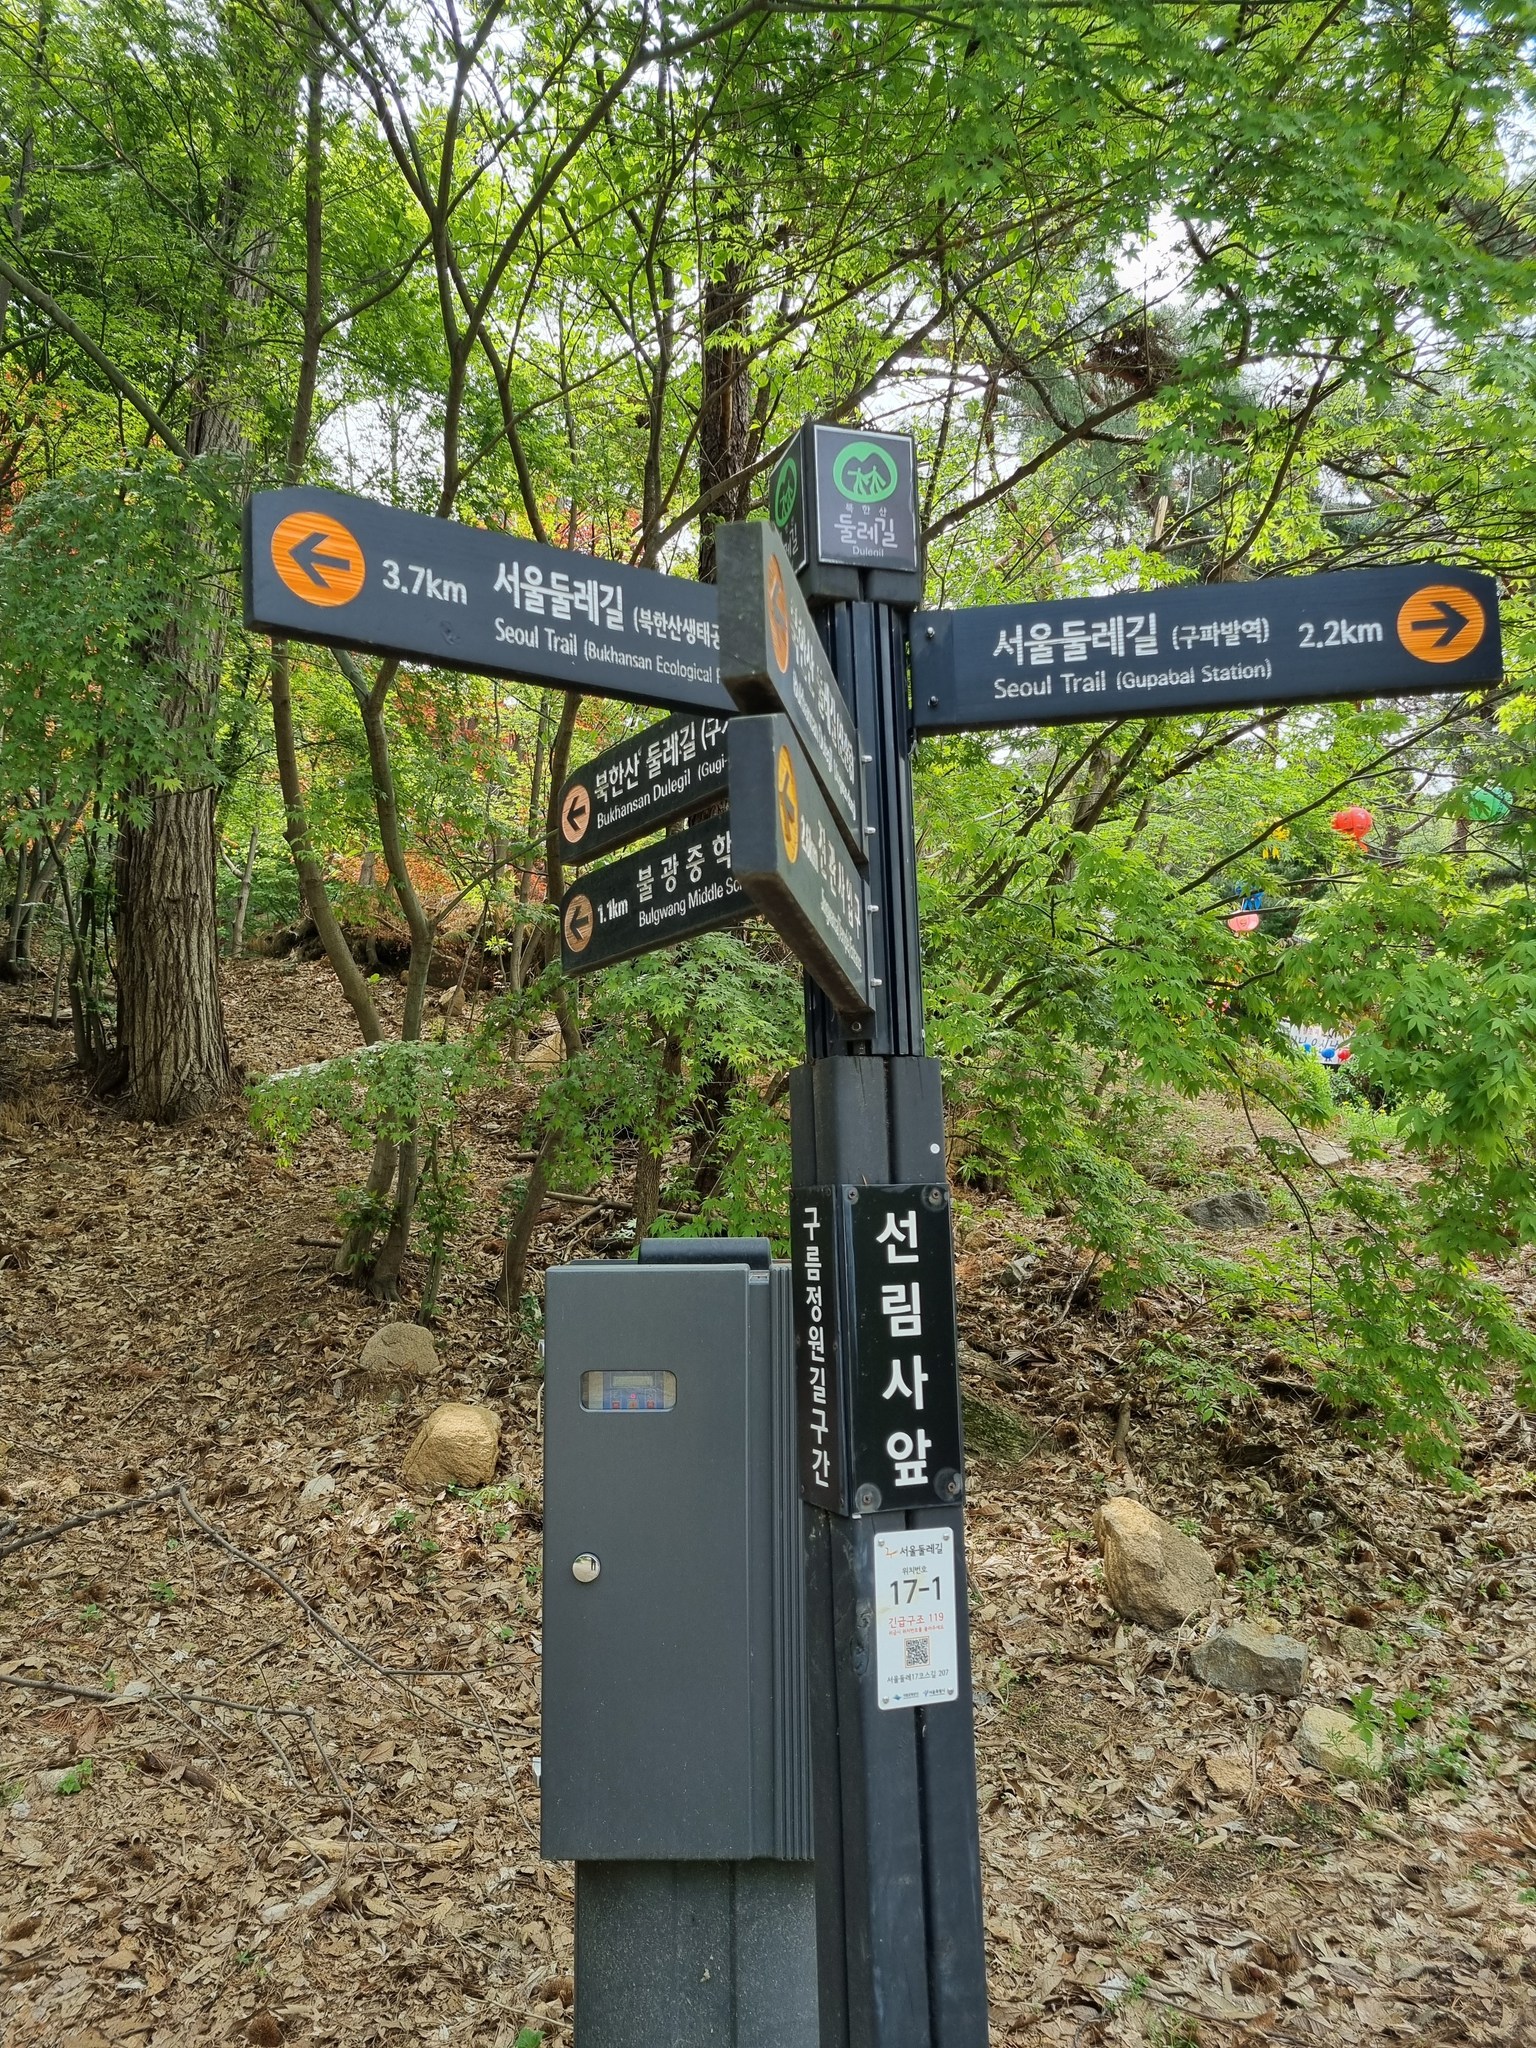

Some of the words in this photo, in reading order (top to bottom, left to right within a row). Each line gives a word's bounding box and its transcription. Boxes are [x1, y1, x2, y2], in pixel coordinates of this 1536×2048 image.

[833, 513, 898, 549] 둘레길
[382, 559, 468, 606] 3.7km
[493, 561, 625, 632] 서울둘레길
[494, 617, 539, 649] Seoul
[544, 627, 578, 657] Trail
[584, 638, 653, 672] (Bukhansan
[656, 655, 713, 683] Ecological
[992, 612, 1159, 666] 서울둘레길
[1172, 617, 1270, 650] (구파발역)
[1298, 618, 1384, 649] 2.2km
[994, 675, 1052, 699] Seoul
[1060, 670, 1106, 694] Trail
[1116, 665, 1196, 691] (Gupabal
[1201, 658, 1273, 684] Station)
[594, 752, 640, 803] 북한산
[646, 721, 697, 780] 둘레길
[597, 793, 651, 829] Bukhansan
[653, 768, 691, 802] Dulegil
[597, 898, 629, 924] 1.1km
[639, 902, 687, 928] Bulgwang
[688, 882, 724, 909] Middle
[726, 876, 742, 895] Sc
[900, 1542, 943, 1557] 서울둘레길
[902, 1565, 928, 1575] 위치번호
[890, 1576, 941, 1605] 17-1
[888, 1614, 925, 1629] 긴급구조
[929, 1612, 944, 1622] 119
[938, 1669, 949, 1677] 207
